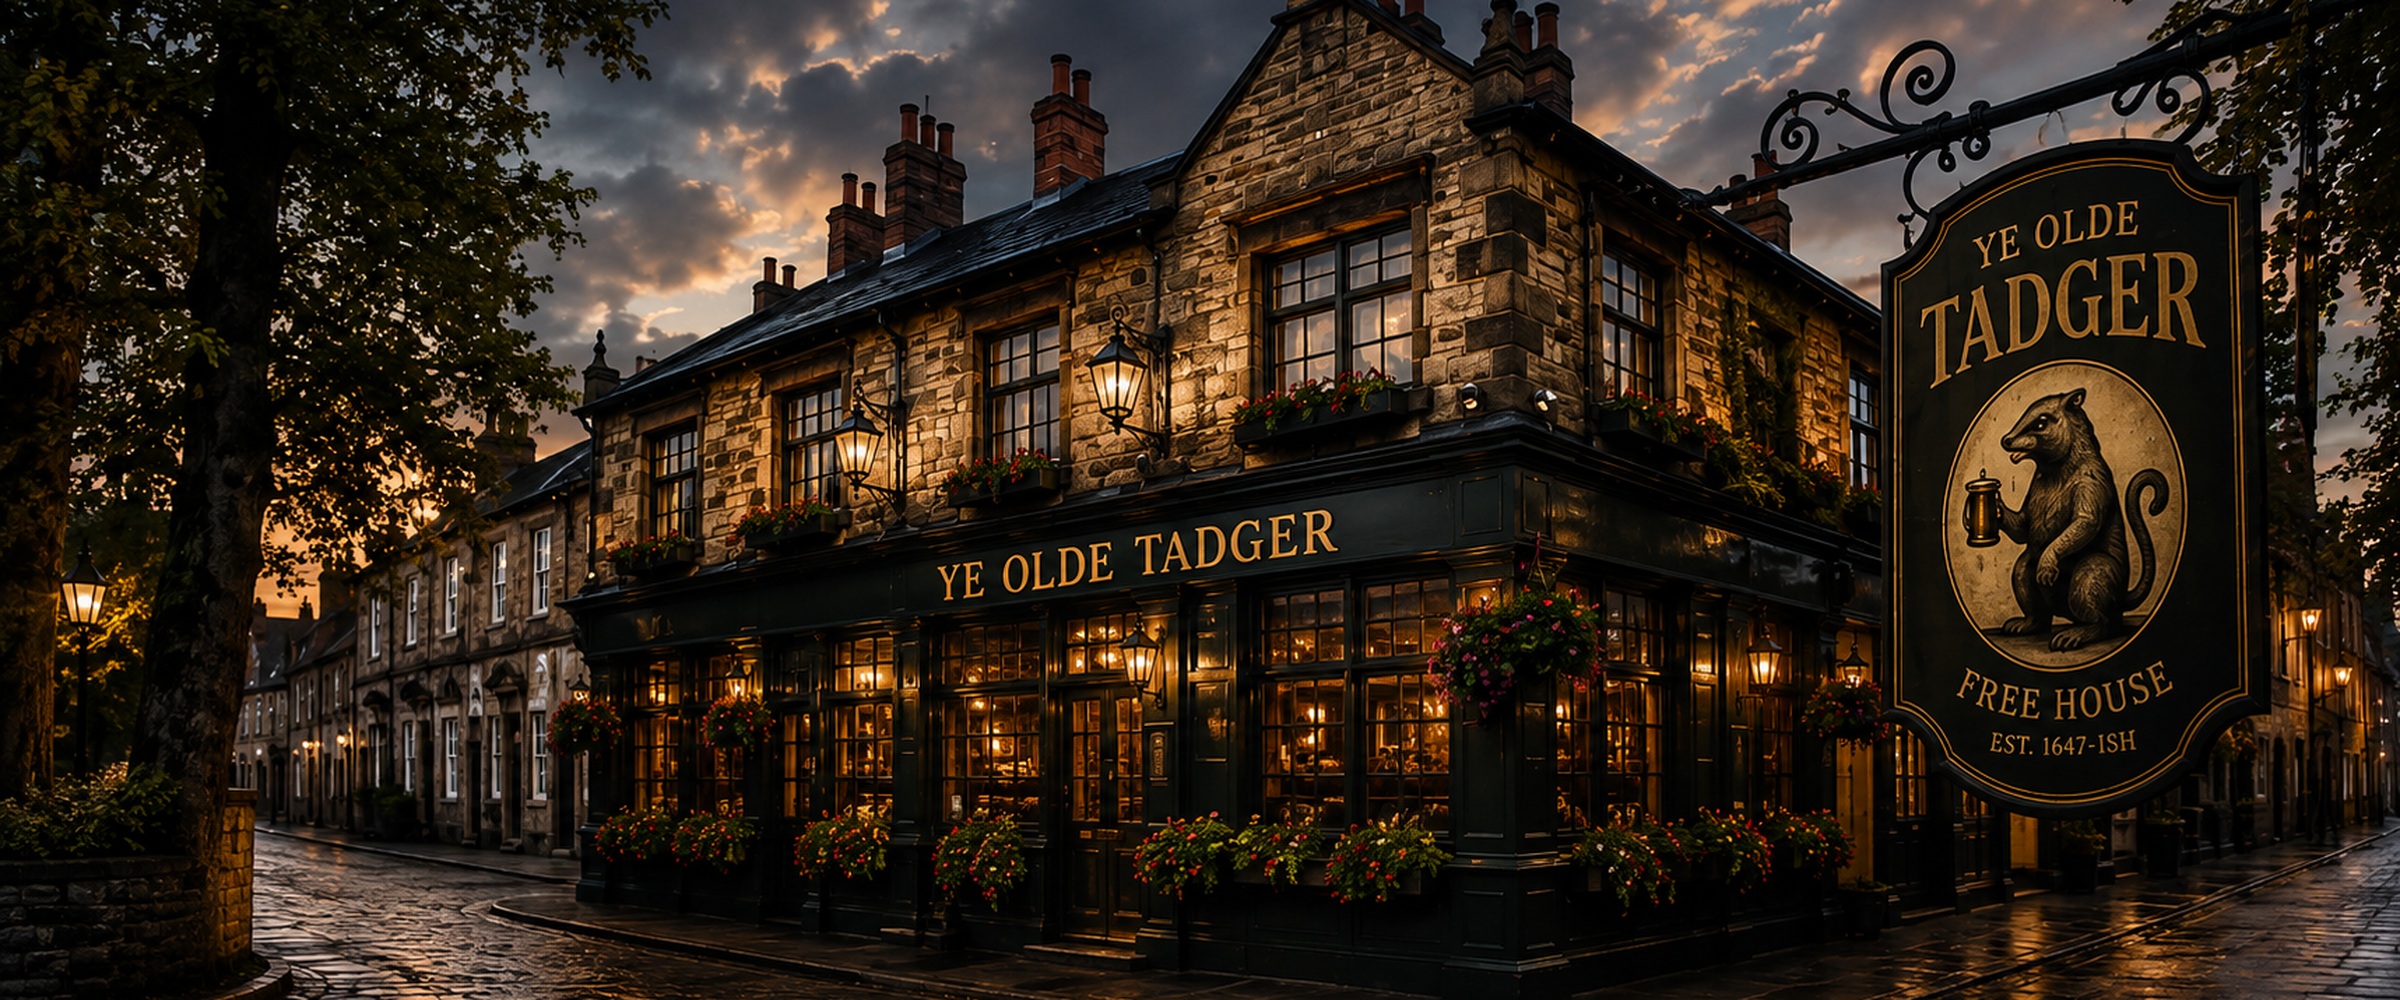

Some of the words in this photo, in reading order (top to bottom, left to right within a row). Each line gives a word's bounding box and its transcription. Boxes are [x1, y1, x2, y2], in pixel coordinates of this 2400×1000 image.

[1972, 225, 2020, 269] YE
[2034, 200, 2139, 249] OLDE
[1920, 250, 2206, 389] TADGER
[937, 560, 985, 601] YE
[1002, 541, 1114, 593] OLDE
[1134, 509, 1339, 576] TADGER
[1956, 667, 2041, 720] FREE
[2054, 660, 2173, 720] HOUSE
[1990, 731, 2034, 756] EST.
[2042, 730, 2137, 756] 1647-ISH
